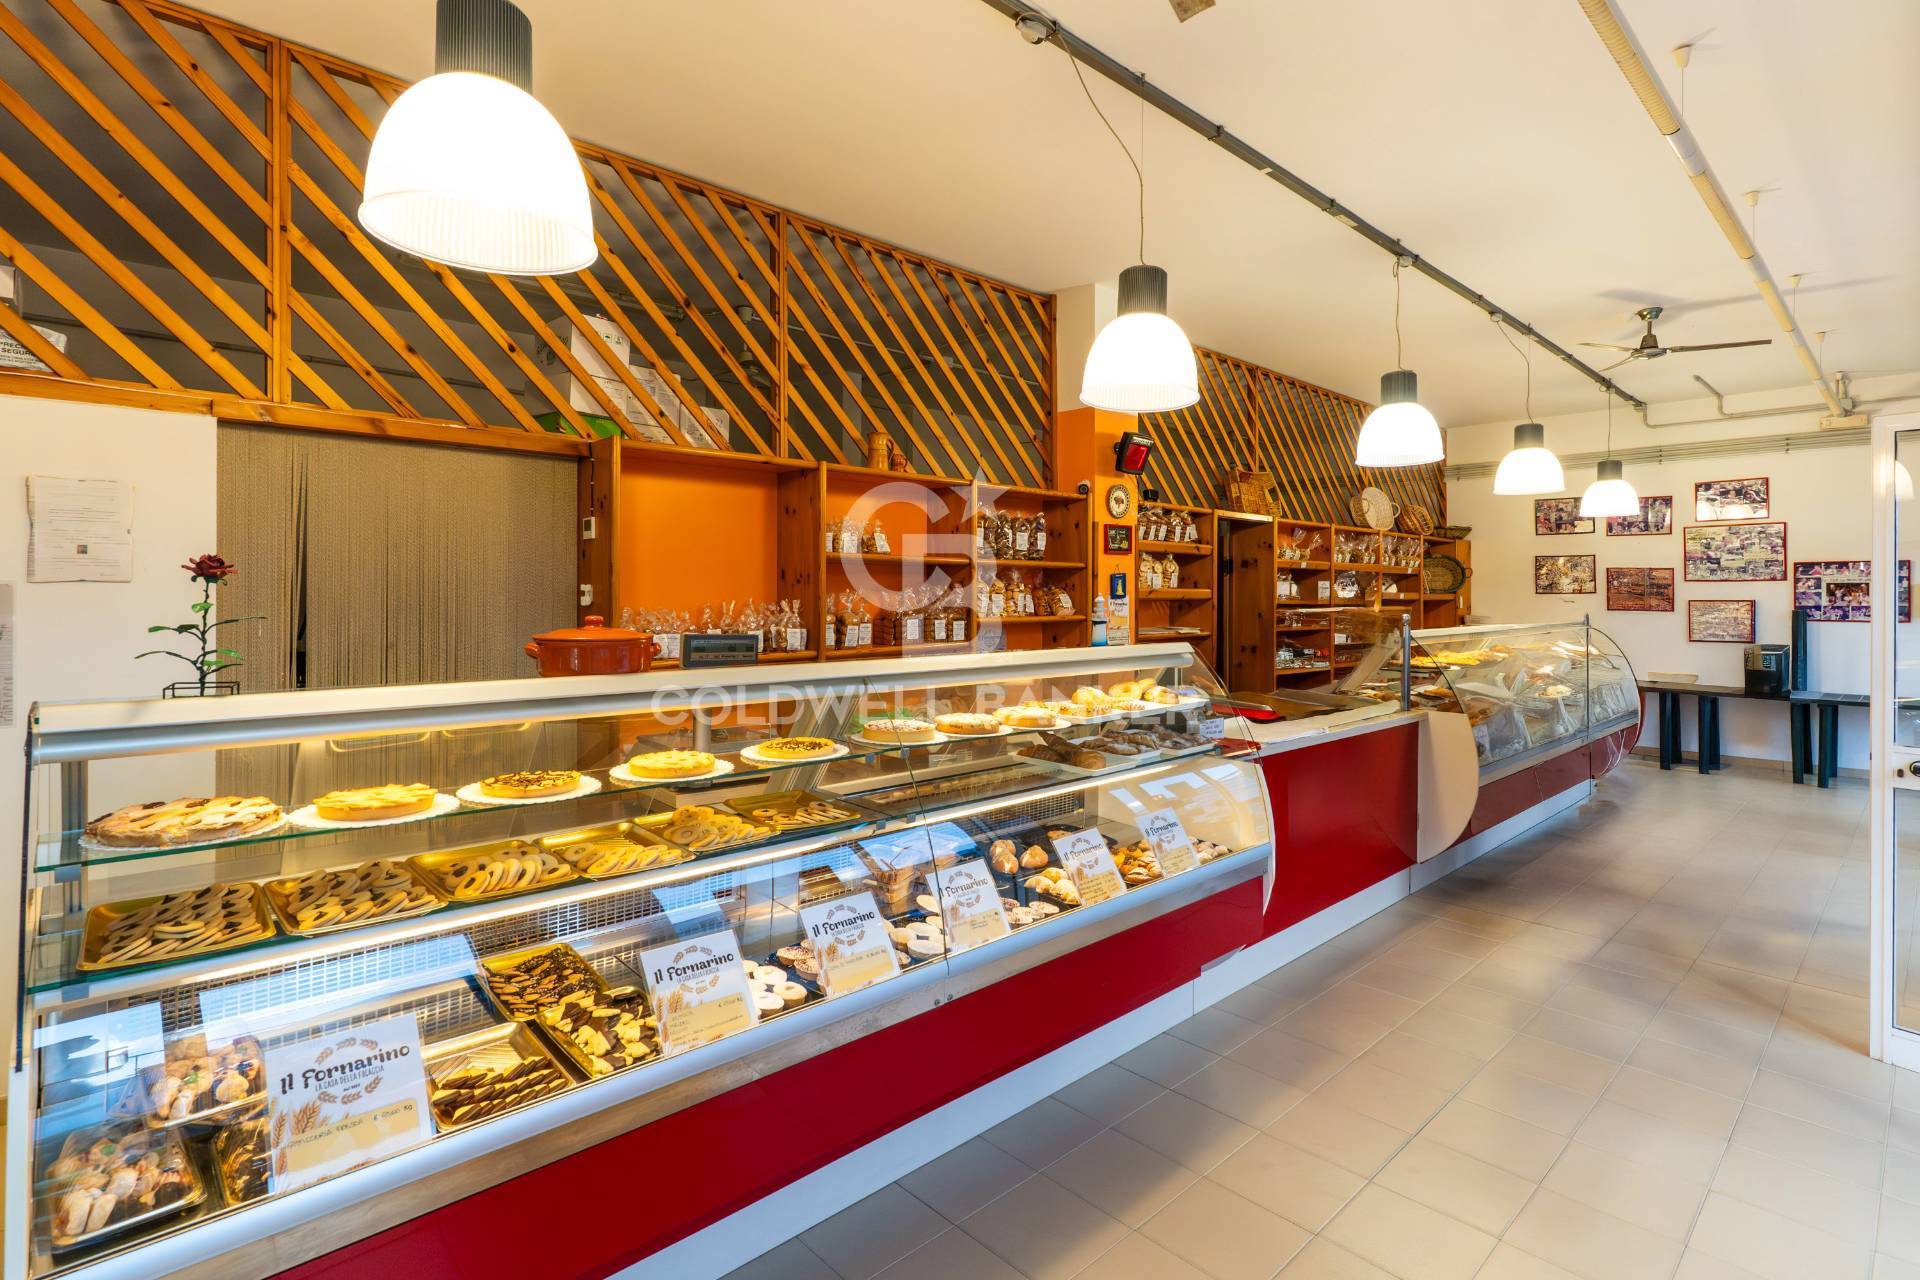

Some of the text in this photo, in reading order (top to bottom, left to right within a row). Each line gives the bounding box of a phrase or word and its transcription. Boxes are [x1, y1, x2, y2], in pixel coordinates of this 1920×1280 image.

[812, 924, 821, 938] Il
[822, 911, 875, 935] Fornarino
[654, 953, 734, 984] Il Fornarino
[280, 1045, 410, 1095] Il Fornarino
[324, 1078, 339, 1089] CASA
[340, 1073, 358, 1086] DELLA
[358, 1065, 384, 1082] FOCACCIA
